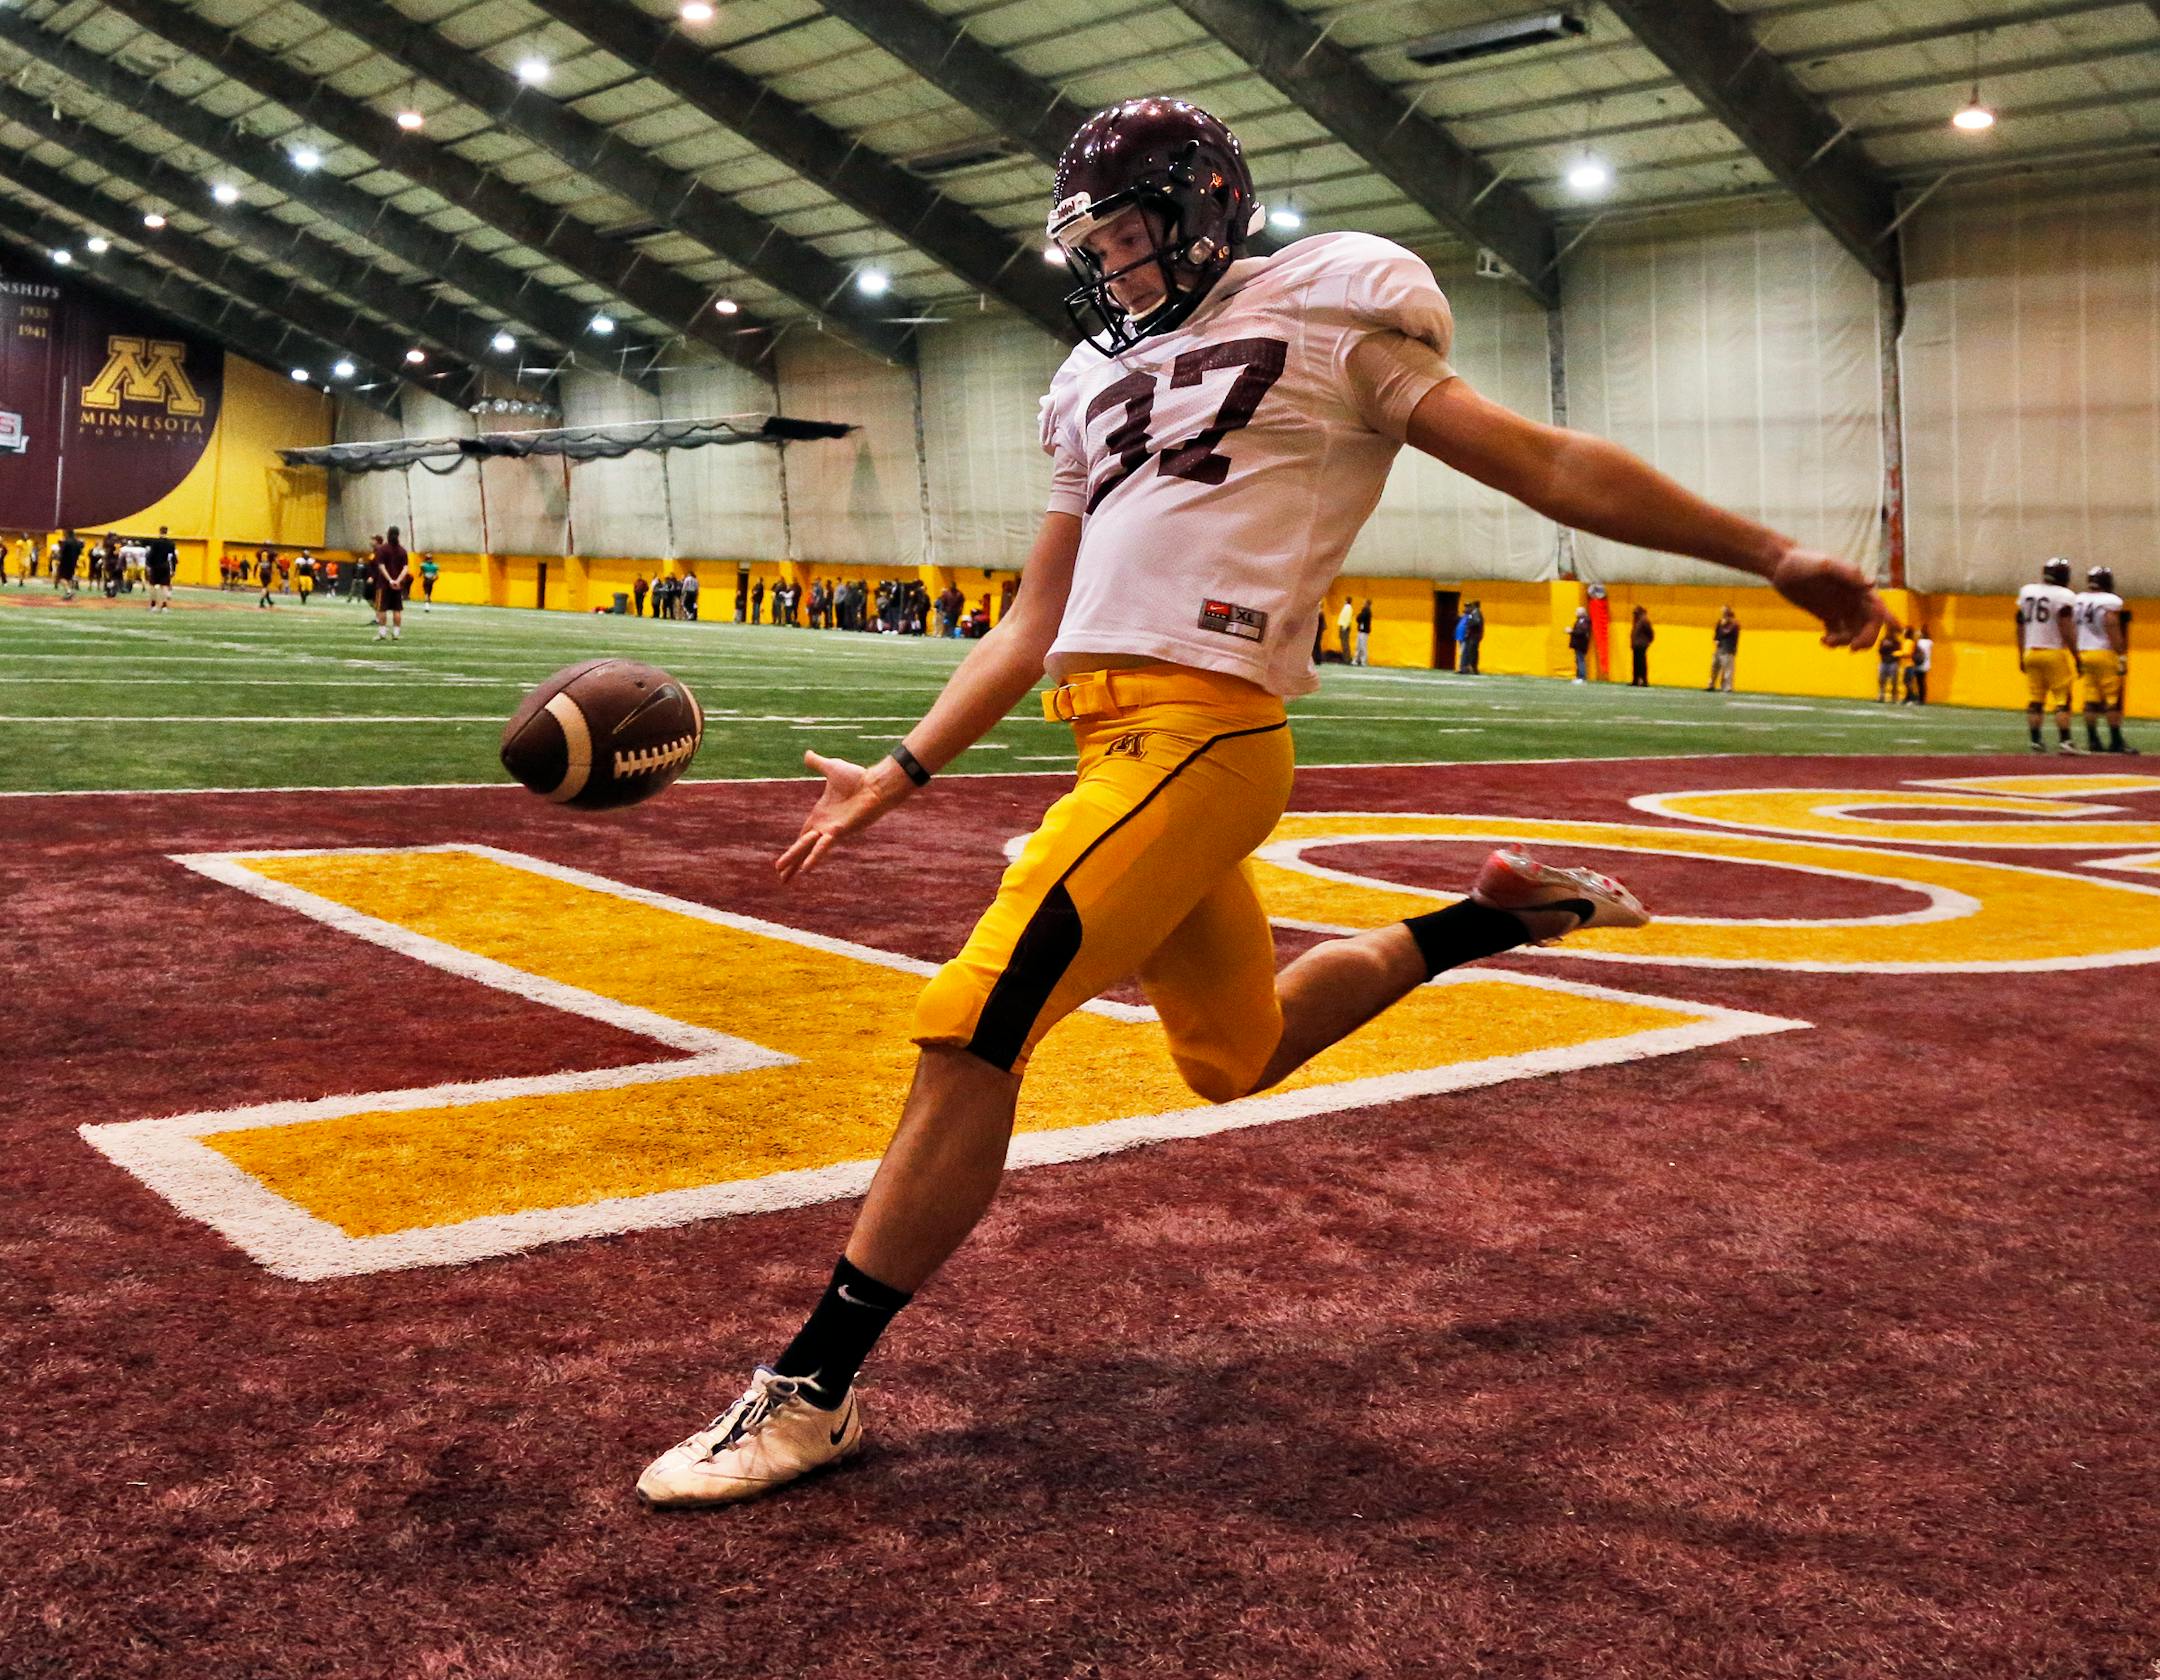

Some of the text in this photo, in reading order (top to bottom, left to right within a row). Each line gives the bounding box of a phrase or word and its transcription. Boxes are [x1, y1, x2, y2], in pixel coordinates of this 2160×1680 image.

[18, 324, 46, 338] 1941
[81, 335, 205, 416] M
[80, 411, 202, 433] MINNESOTA
[1236, 608, 1254, 624] XL
[2022, 596, 2050, 623] 76
